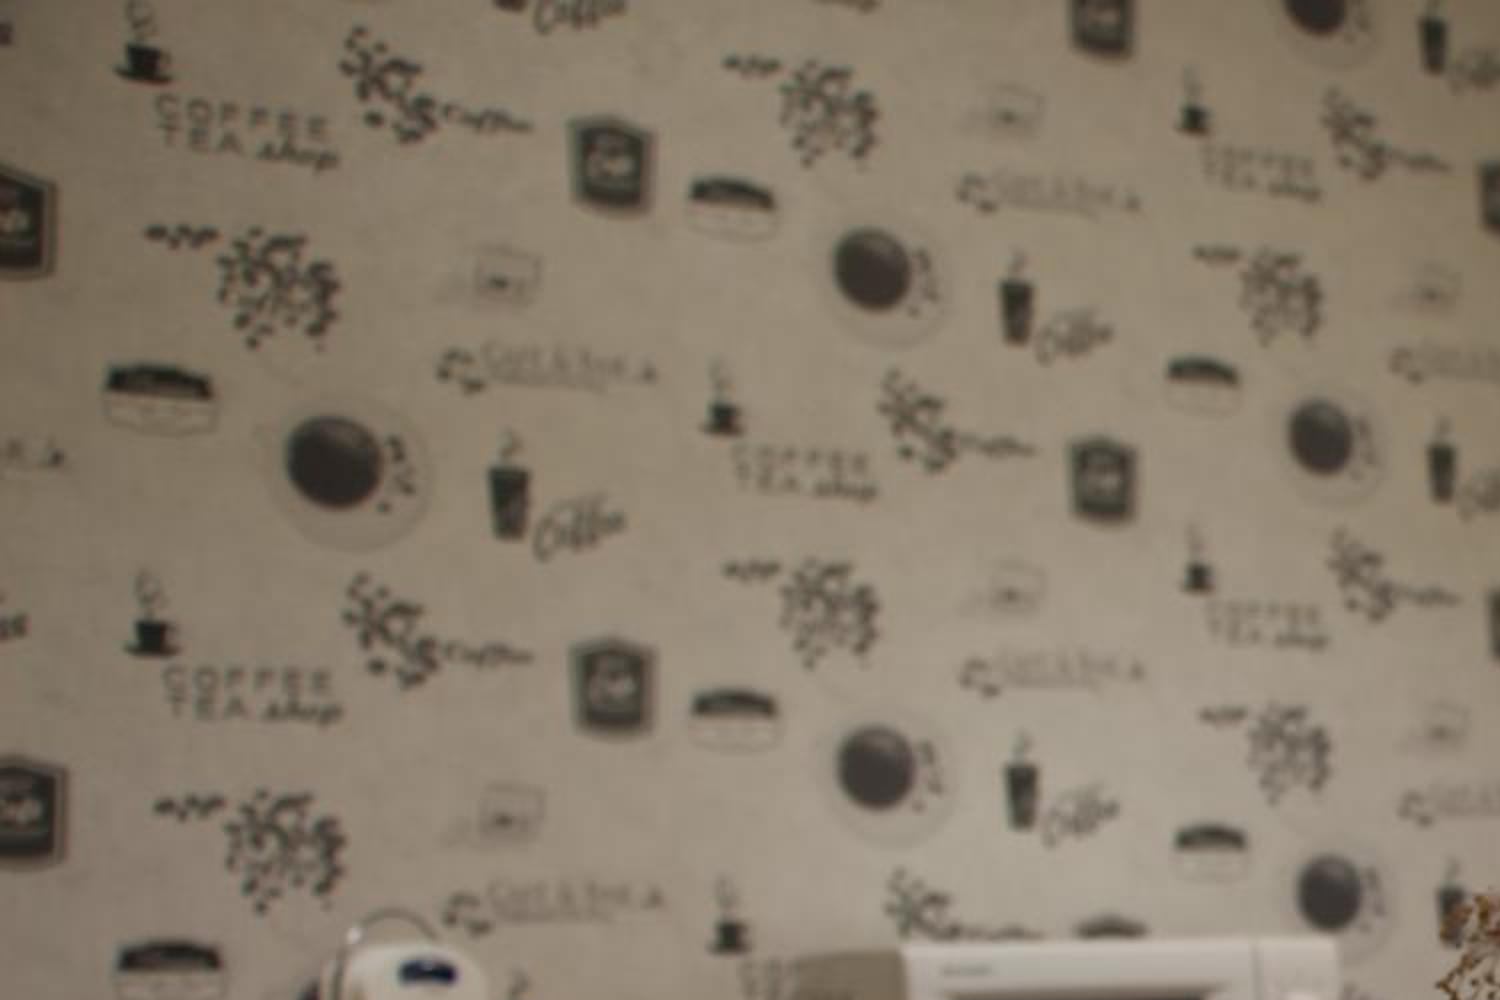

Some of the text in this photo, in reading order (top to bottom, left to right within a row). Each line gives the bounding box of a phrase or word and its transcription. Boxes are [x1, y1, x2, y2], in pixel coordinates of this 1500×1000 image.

[153, 92, 332, 141] COFFEE
[156, 122, 343, 173] TEA shop
[160, 662, 334, 697] COFFEE
[166, 694, 347, 727] TEA shop
